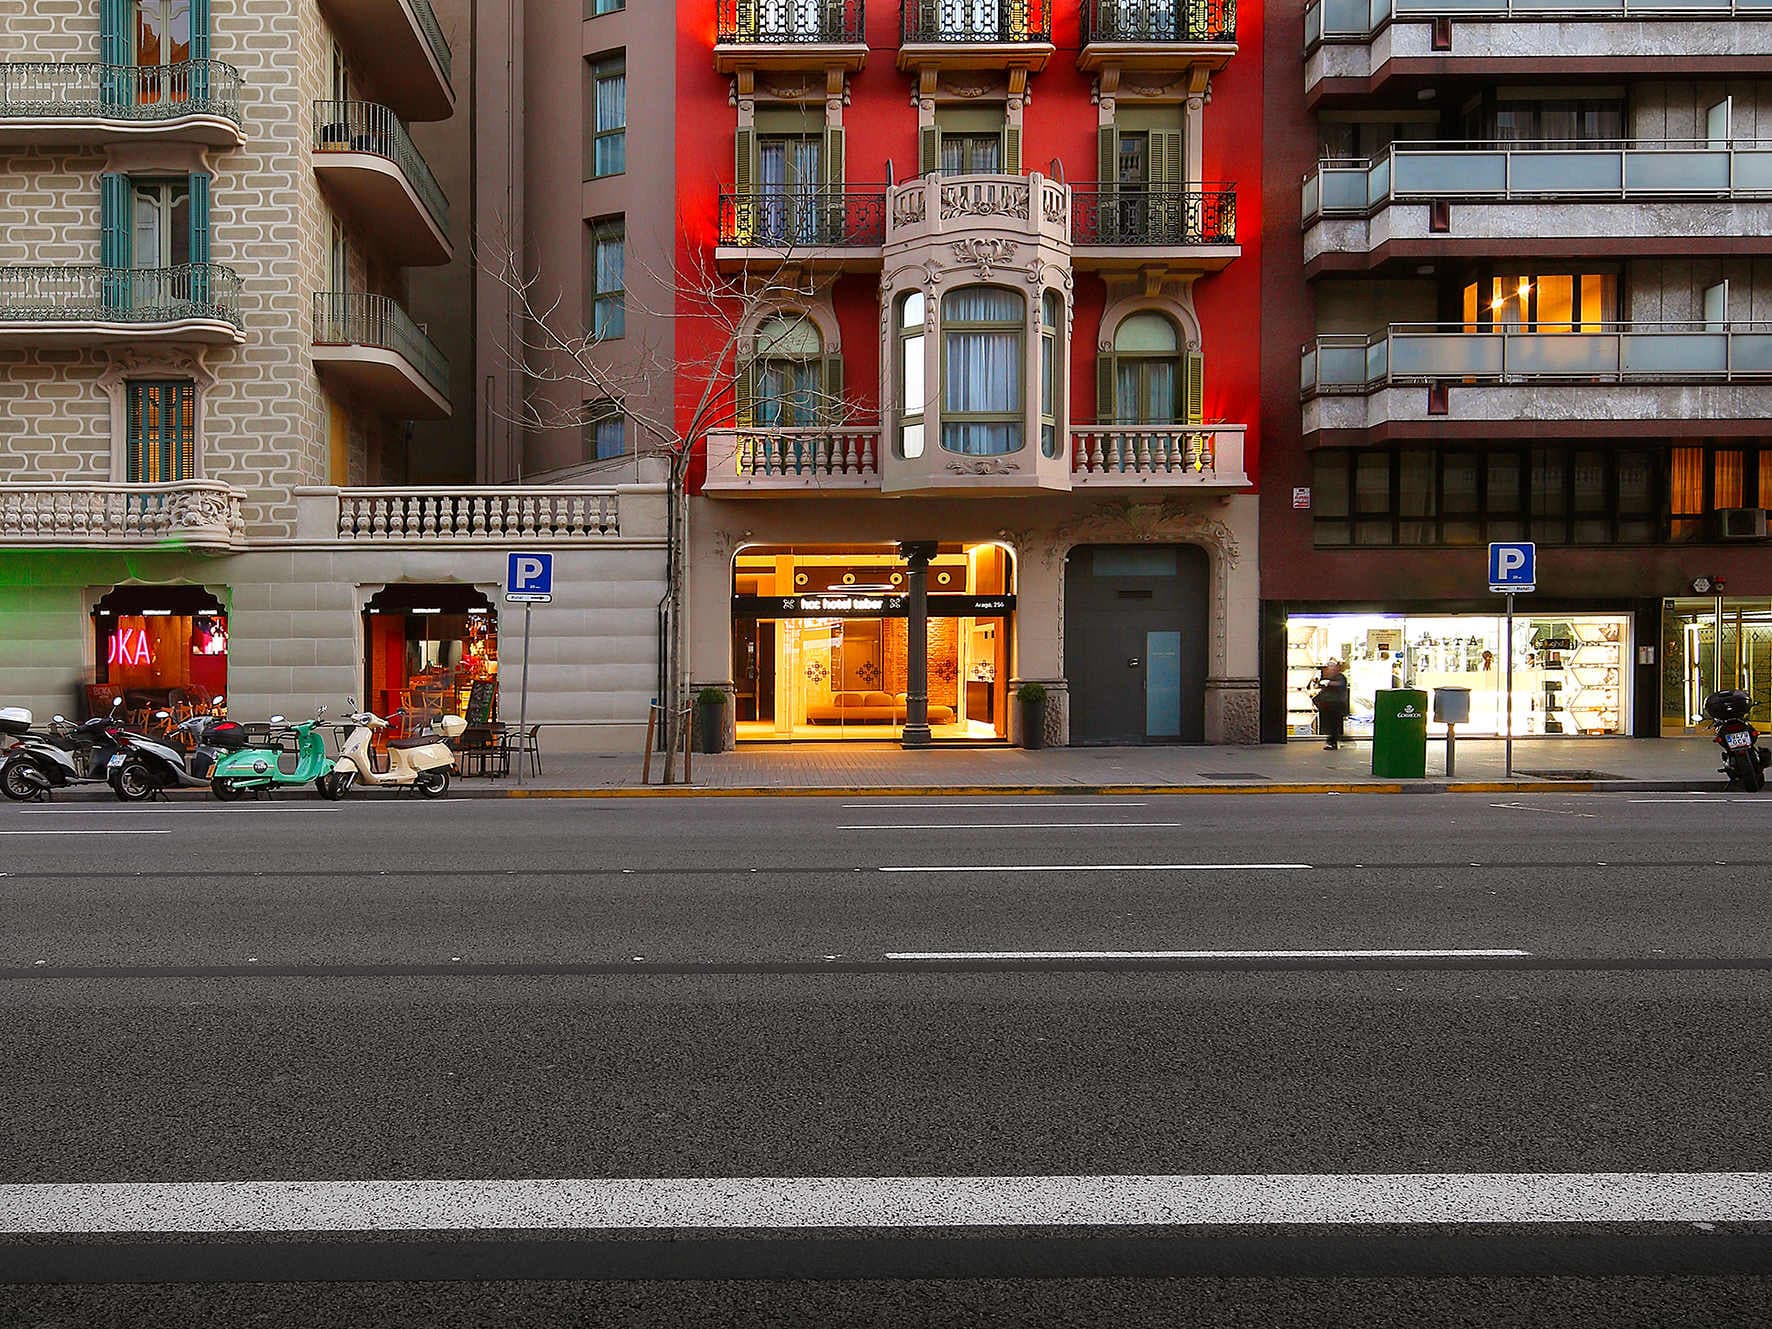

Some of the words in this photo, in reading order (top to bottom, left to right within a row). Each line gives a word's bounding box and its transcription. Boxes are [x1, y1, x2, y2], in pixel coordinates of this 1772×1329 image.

[517, 558, 543, 589] P
[1498, 548, 1525, 579] P
[822, 597, 851, 610] hotel
